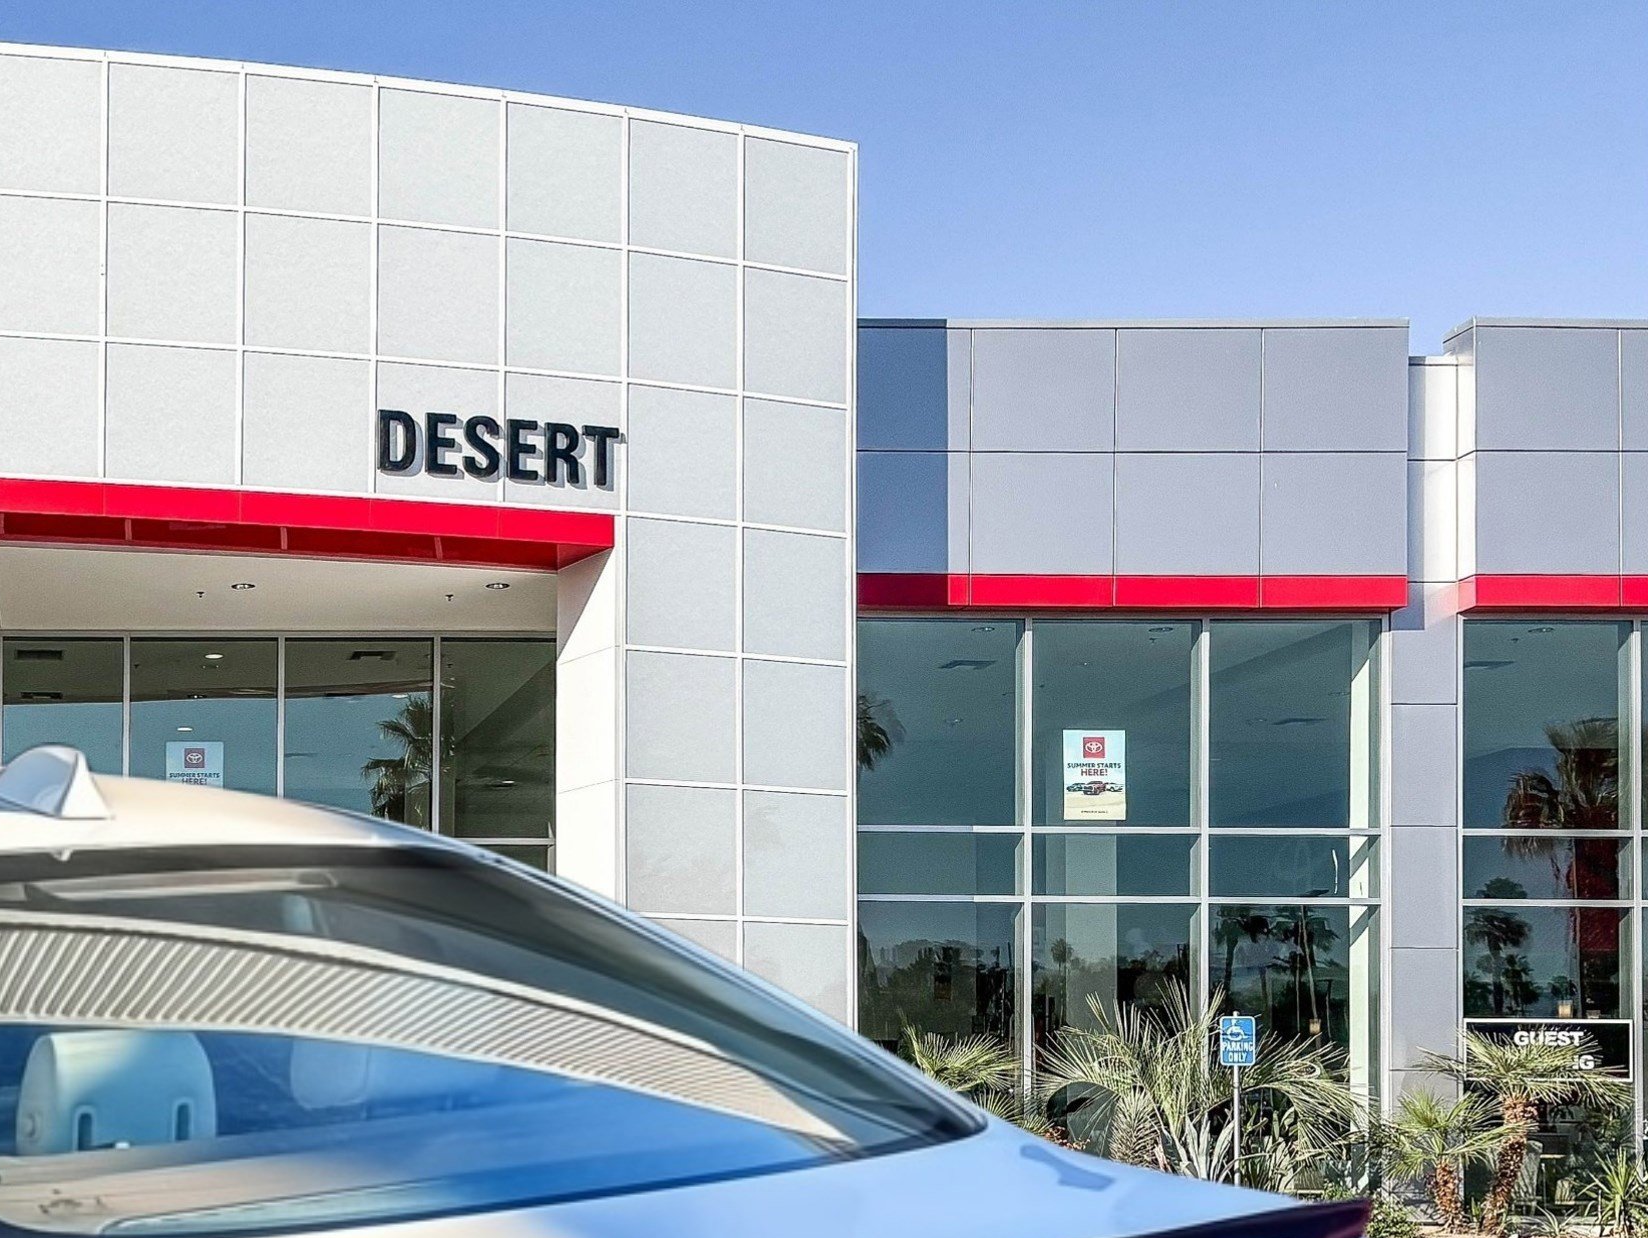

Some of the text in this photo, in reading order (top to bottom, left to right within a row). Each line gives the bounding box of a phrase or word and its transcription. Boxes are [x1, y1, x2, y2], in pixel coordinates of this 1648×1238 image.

[377, 409, 620, 487] DESERT
[1080, 768, 1108, 777] HERE!
[1513, 1031, 1585, 1047] GUEST
[1221, 1041, 1254, 1052] PARKING
[1228, 1052, 1248, 1063] ONLY
